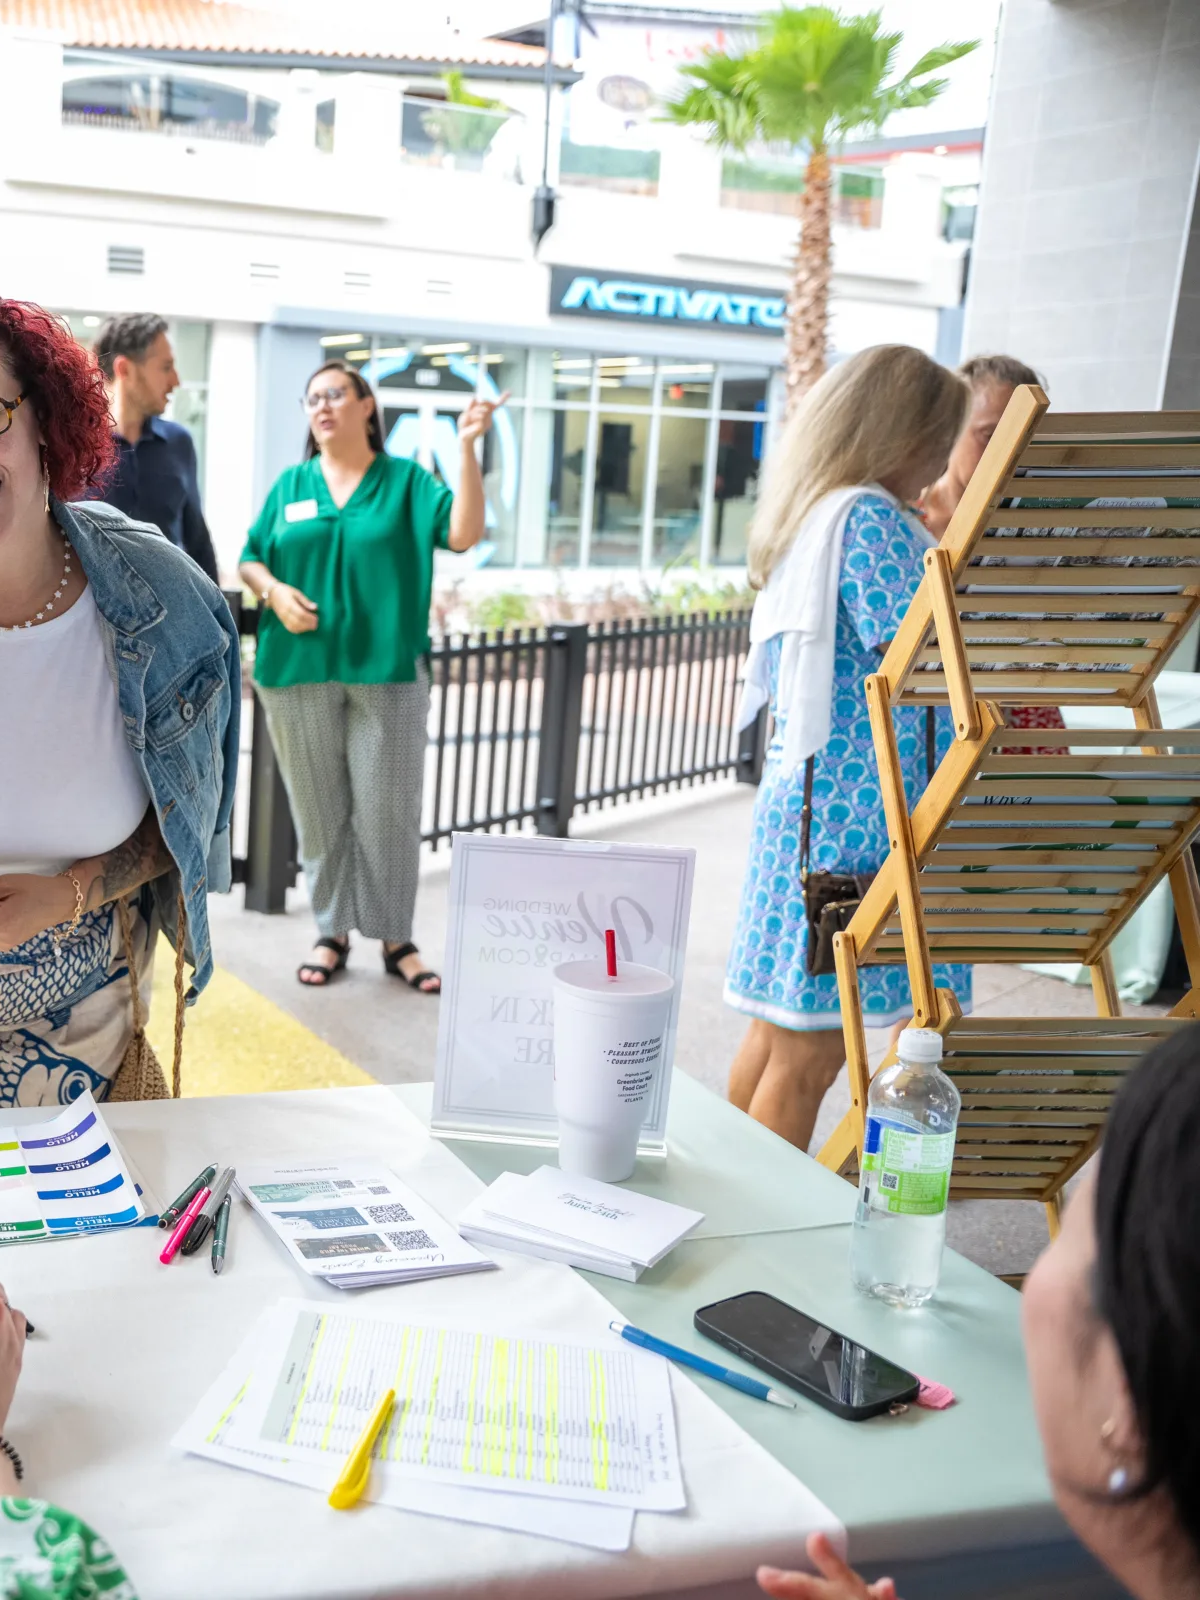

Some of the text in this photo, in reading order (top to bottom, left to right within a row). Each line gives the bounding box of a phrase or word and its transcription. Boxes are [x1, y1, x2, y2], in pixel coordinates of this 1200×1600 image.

[1129, 499, 1157, 508] CREEK
[607, 1049, 640, 1057] PLEASANT
[616, 1077, 645, 1085] Greenbriar
[46, 1131, 79, 1146] HELLO
[55, 1160, 89, 1172] HELLO
[64, 1188, 101, 1198] HELLO
[563, 1199, 618, 1220] June 24th
[75, 1217, 112, 1226] HELLO
[375, 1253, 445, 1264] Upcoming
